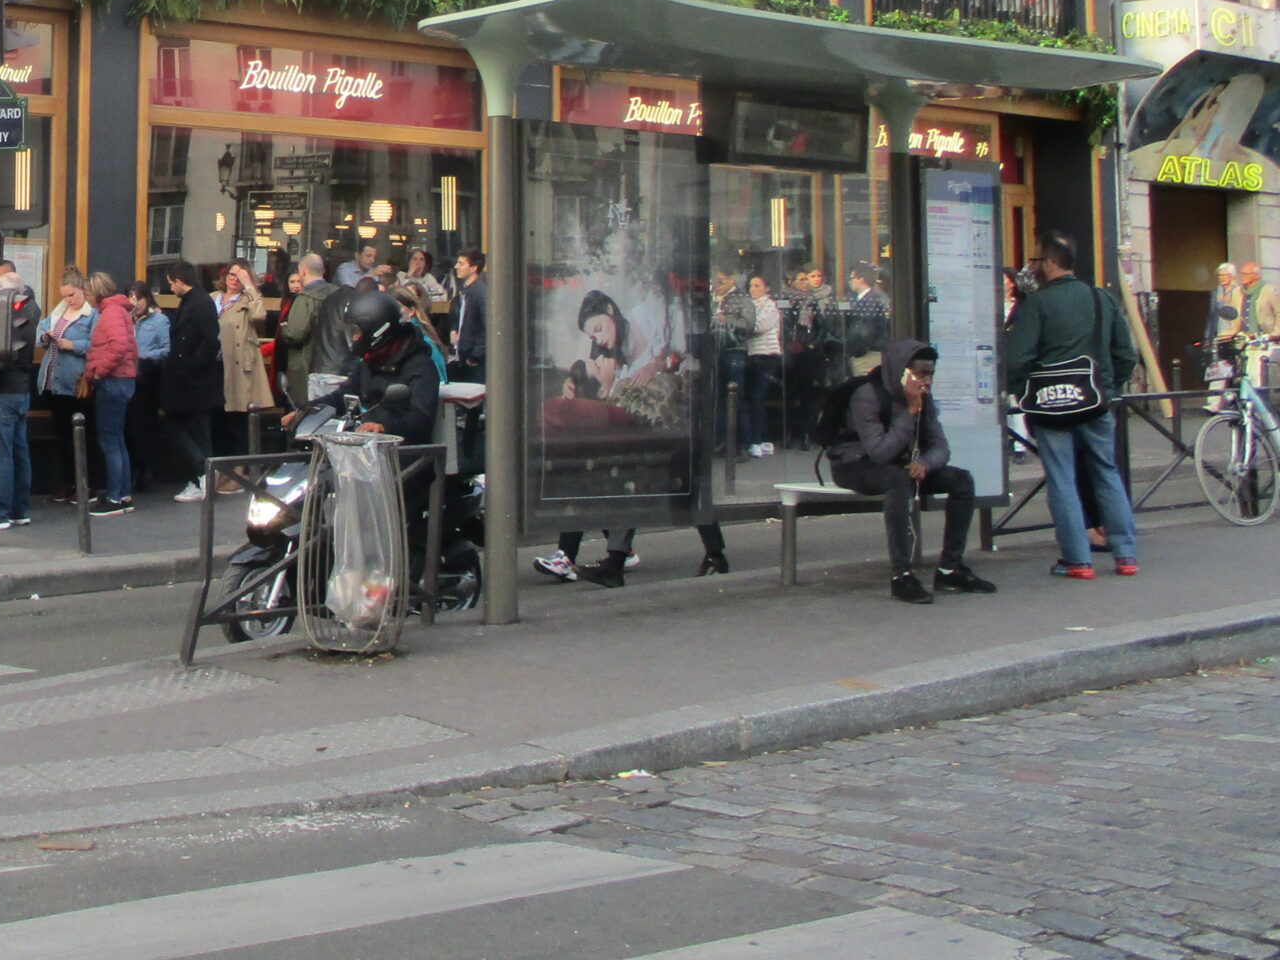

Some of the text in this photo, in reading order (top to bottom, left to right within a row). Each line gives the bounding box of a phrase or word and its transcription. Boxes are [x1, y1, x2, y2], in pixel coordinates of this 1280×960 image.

[1122, 7, 1191, 39] CINEMA
[240, 60, 384, 109] Bouillon Pigalle
[623, 96, 683, 126] Bouillon
[925, 128, 966, 158] Pigalle
[1157, 155, 1264, 192] ATLAS
